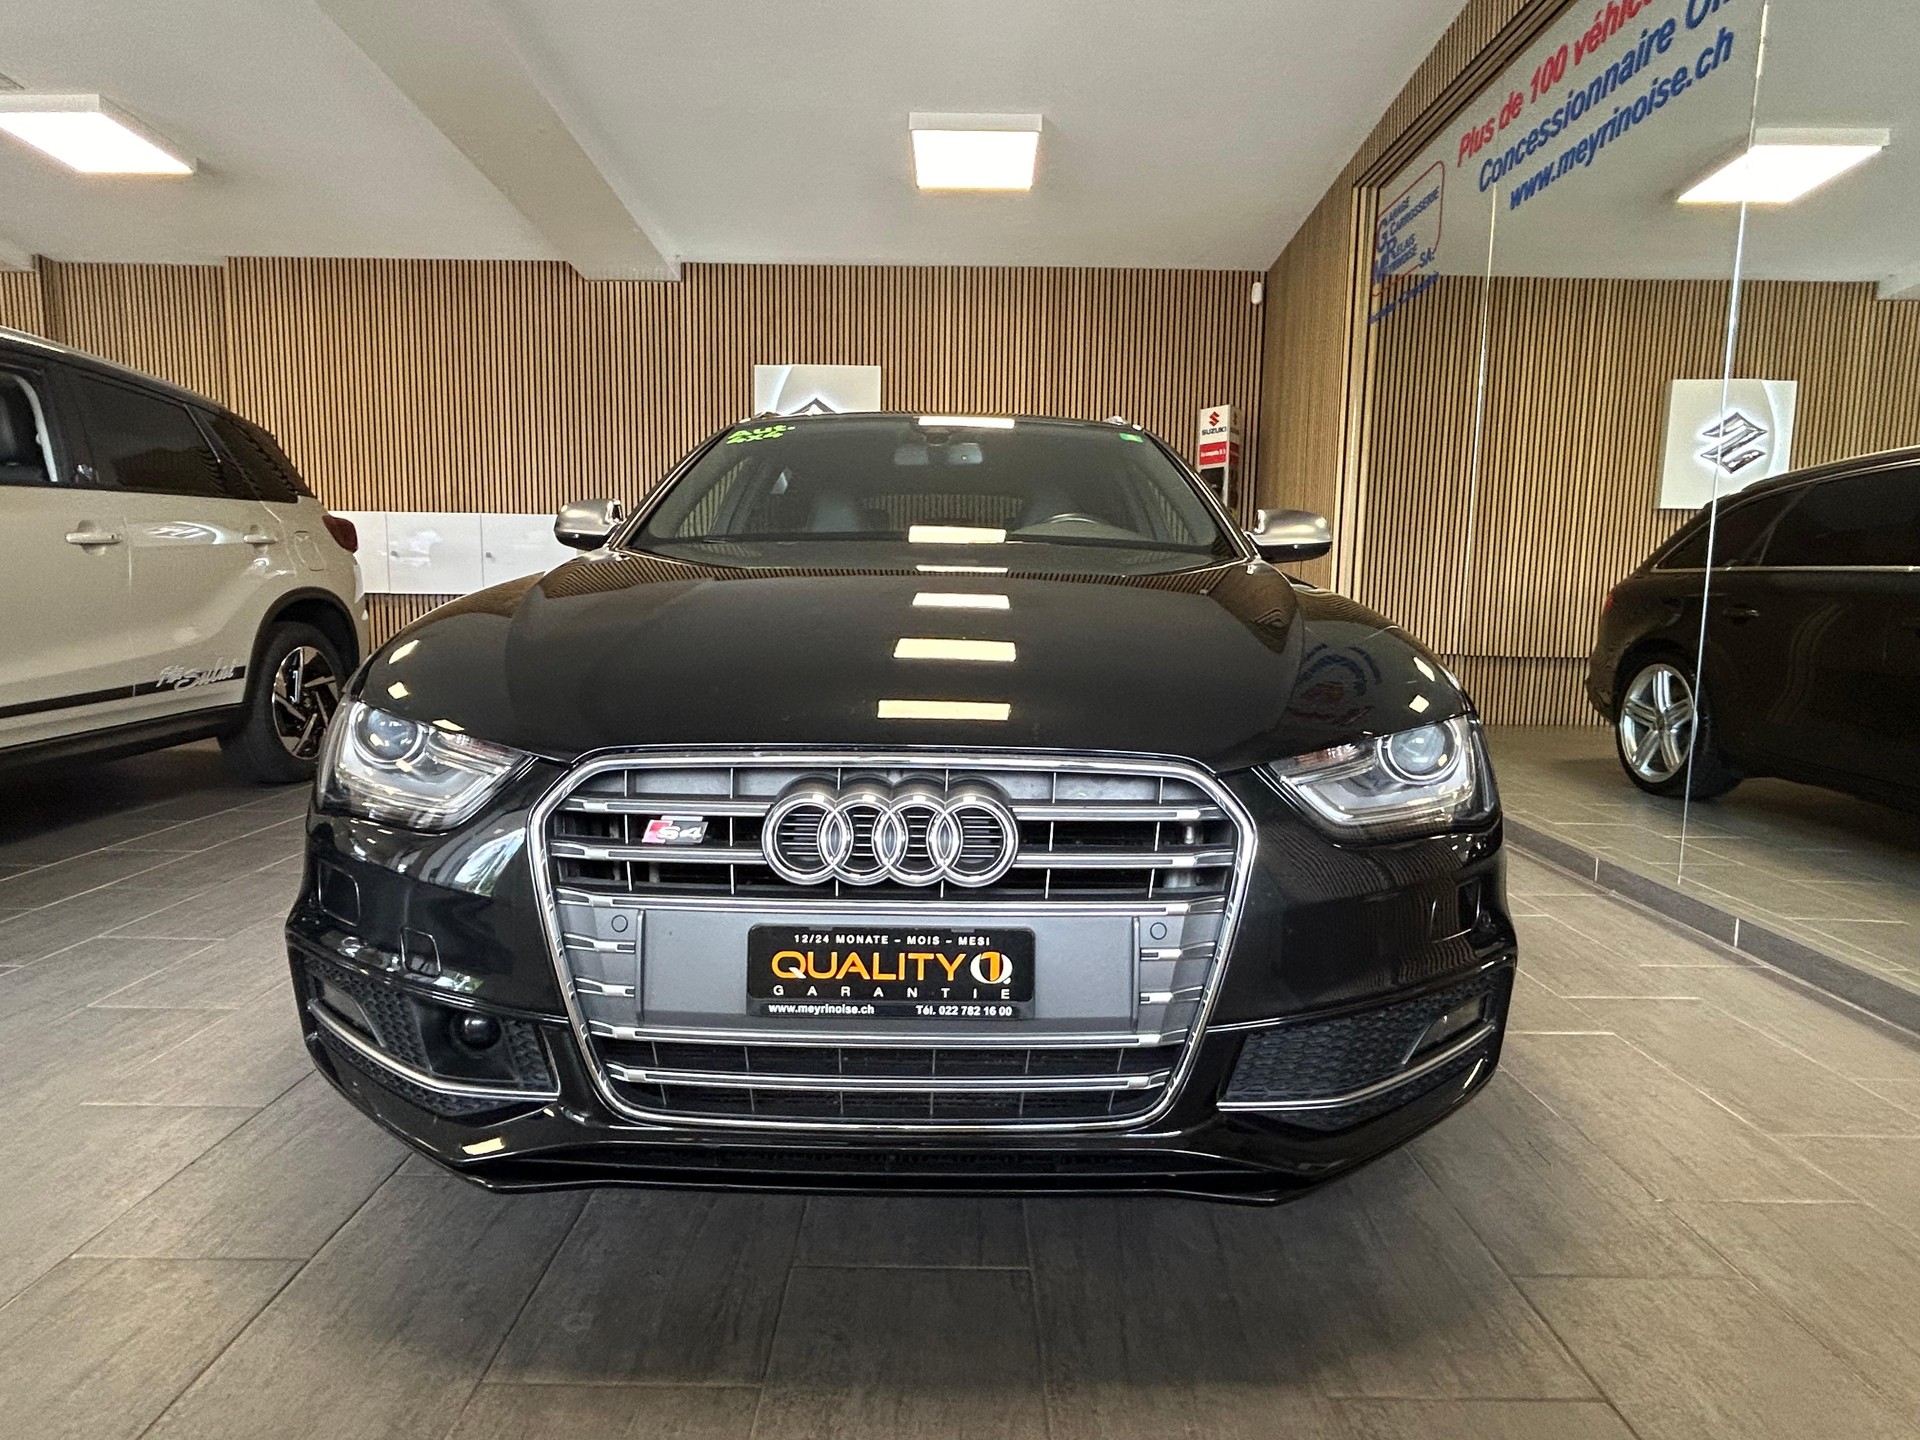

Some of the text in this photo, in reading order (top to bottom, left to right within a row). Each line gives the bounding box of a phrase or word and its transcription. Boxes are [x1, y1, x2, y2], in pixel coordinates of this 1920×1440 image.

[1456, 118, 1496, 168] Plus
[1498, 91, 1524, 131] de
[1530, 44, 1568, 104] 100
[1574, 0, 1652, 66] véhic
[1479, 17, 1676, 193] Concessionnaire
[1510, 26, 1734, 210] www.meyrinoise.ch
[1201, 426, 1227, 436] SUZUKI
[656, 825, 703, 841] S4
[794, 934, 830, 944] 12/24
[835, 934, 889, 945] MONATE
[906, 935, 940, 945] MOIS
[958, 936, 991, 946] MESI
[771, 950, 967, 981] QUALITY
[773, 985, 1011, 999] GARANTIE
[768, 1004, 875, 1016] www.meyrinoise.ch
[915, 1004, 937, 1016] Tél.
[938, 1005, 959, 1016] 022
[961, 1006, 981, 1016] 782
[983, 1006, 997, 1016] 16
